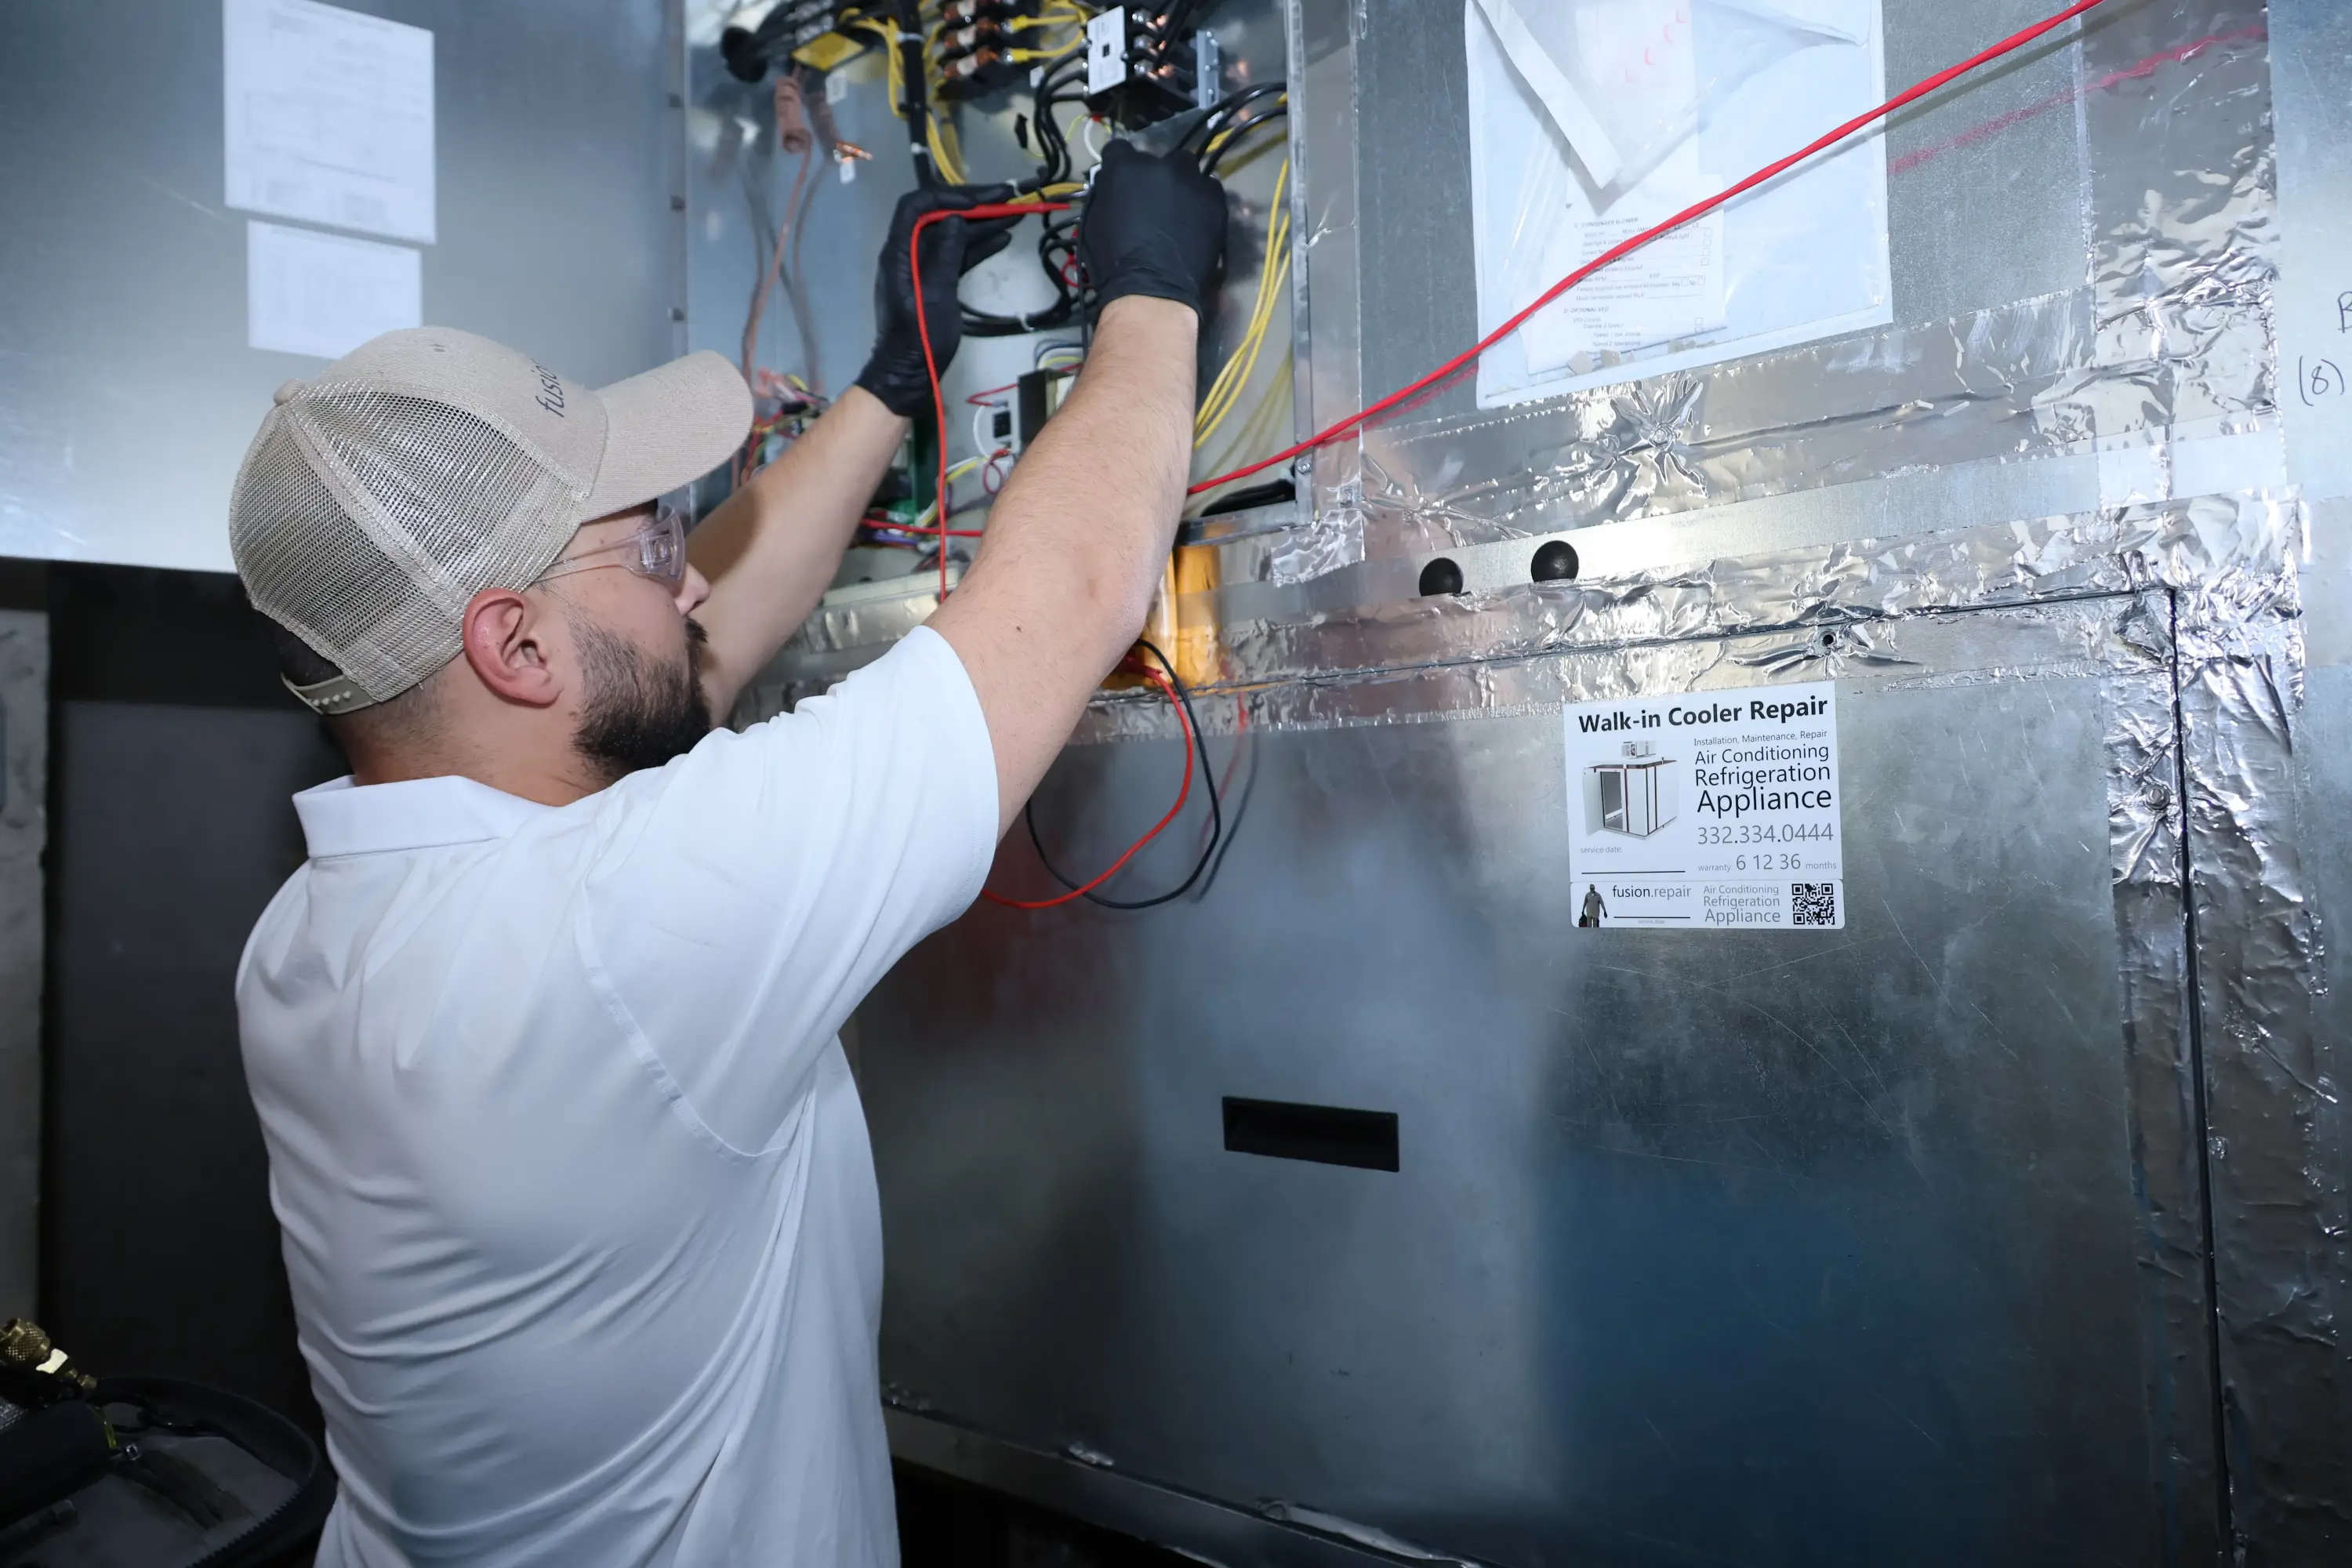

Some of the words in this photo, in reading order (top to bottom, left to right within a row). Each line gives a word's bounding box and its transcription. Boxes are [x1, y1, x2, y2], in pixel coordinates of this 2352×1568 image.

[529, 358, 565, 418] fusio
[1578, 709, 1661, 733] Walk-in
[1668, 702, 1742, 727] Cooler
[1750, 695, 1828, 724] Repair
[1693, 735, 1740, 746] Installation,
[1741, 732, 1798, 743] Maintenance,
[1800, 730, 1828, 740] Repair
[1694, 750, 1717, 765] Air
[1722, 743, 1829, 764] Conditioning
[1695, 762, 1831, 789] Refrigeration
[1697, 786, 1832, 819] Appliance
[1697, 822, 1835, 845] 332.334.0444
[1736, 855, 1747, 870] 6
[1752, 854, 1773, 870] 12
[1779, 853, 1802, 870] 36
[1805, 861, 1838, 870] months
[1612, 885, 1692, 901] fusion.repair
[1703, 885, 1716, 895] Air
[1719, 884, 1780, 895] Conditioning
[1704, 895, 1780, 909] Refrigeration
[1704, 907, 1781, 926] Appliance
